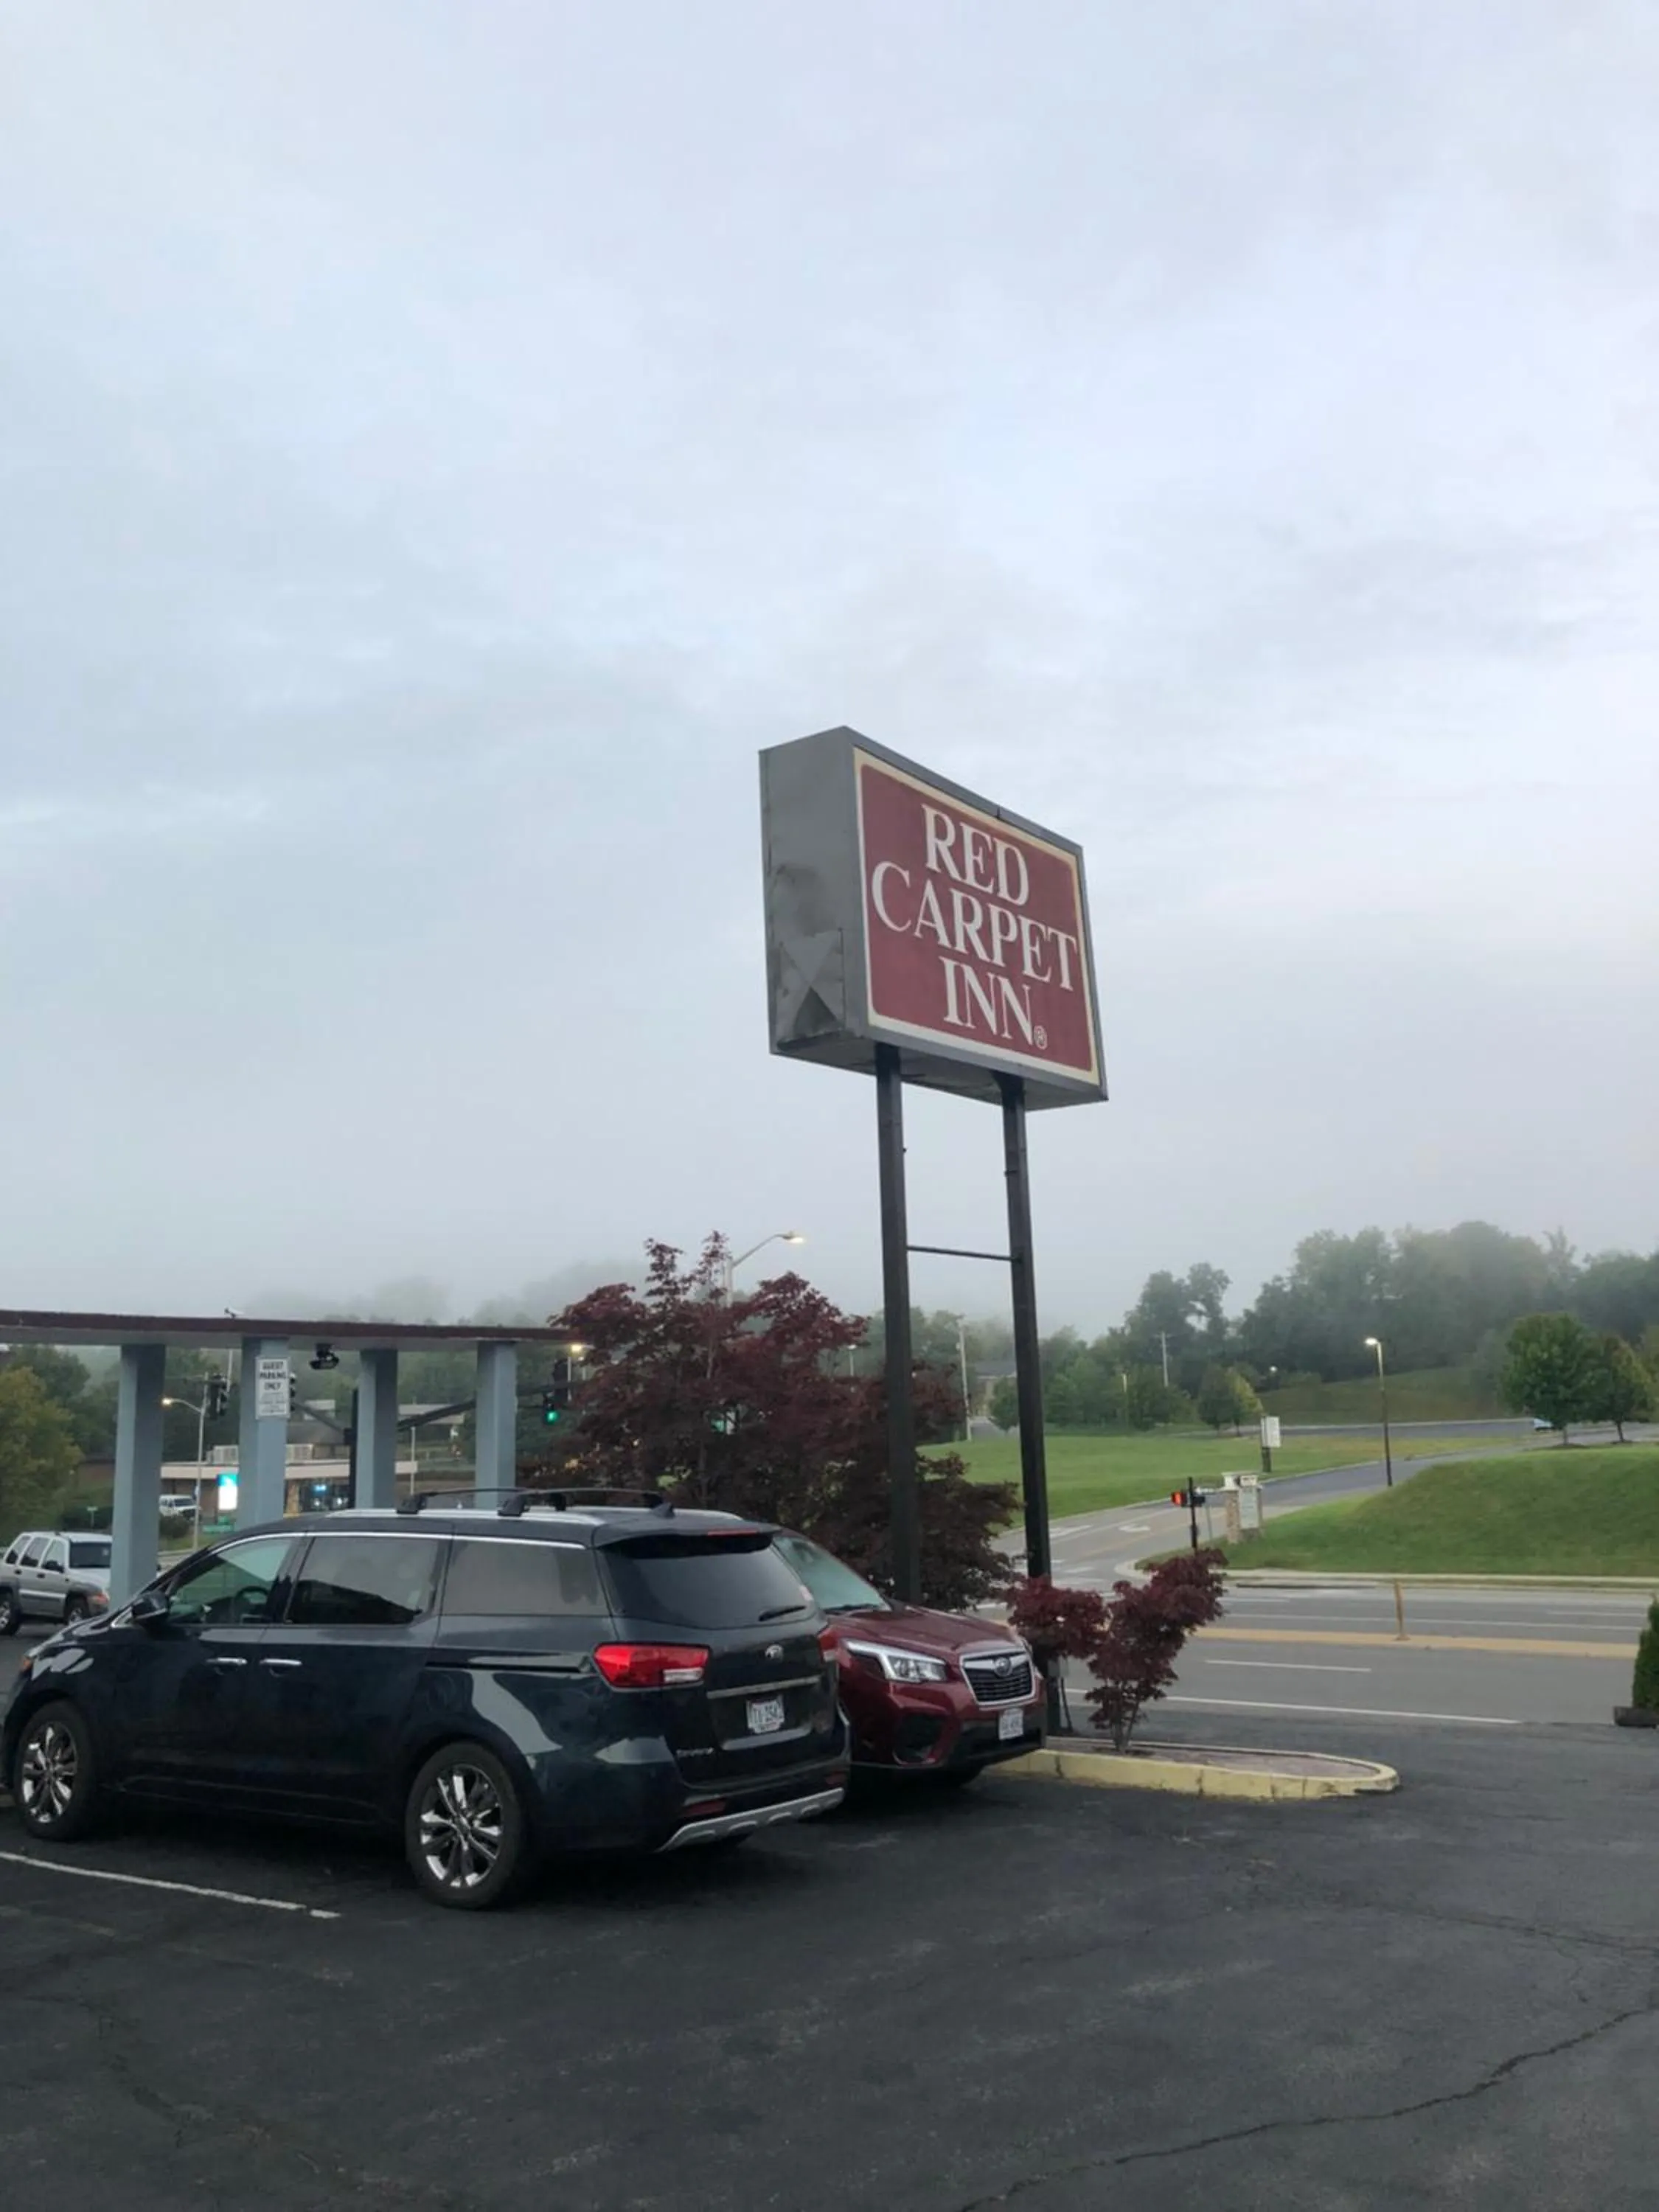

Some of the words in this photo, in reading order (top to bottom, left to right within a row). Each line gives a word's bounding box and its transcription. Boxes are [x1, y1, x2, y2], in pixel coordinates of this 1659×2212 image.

[921, 802, 1029, 906] RED
[872, 860, 1078, 992] CARPET
[939, 956, 1033, 1046] INN
[264, 1382, 282, 1391] ONLY
